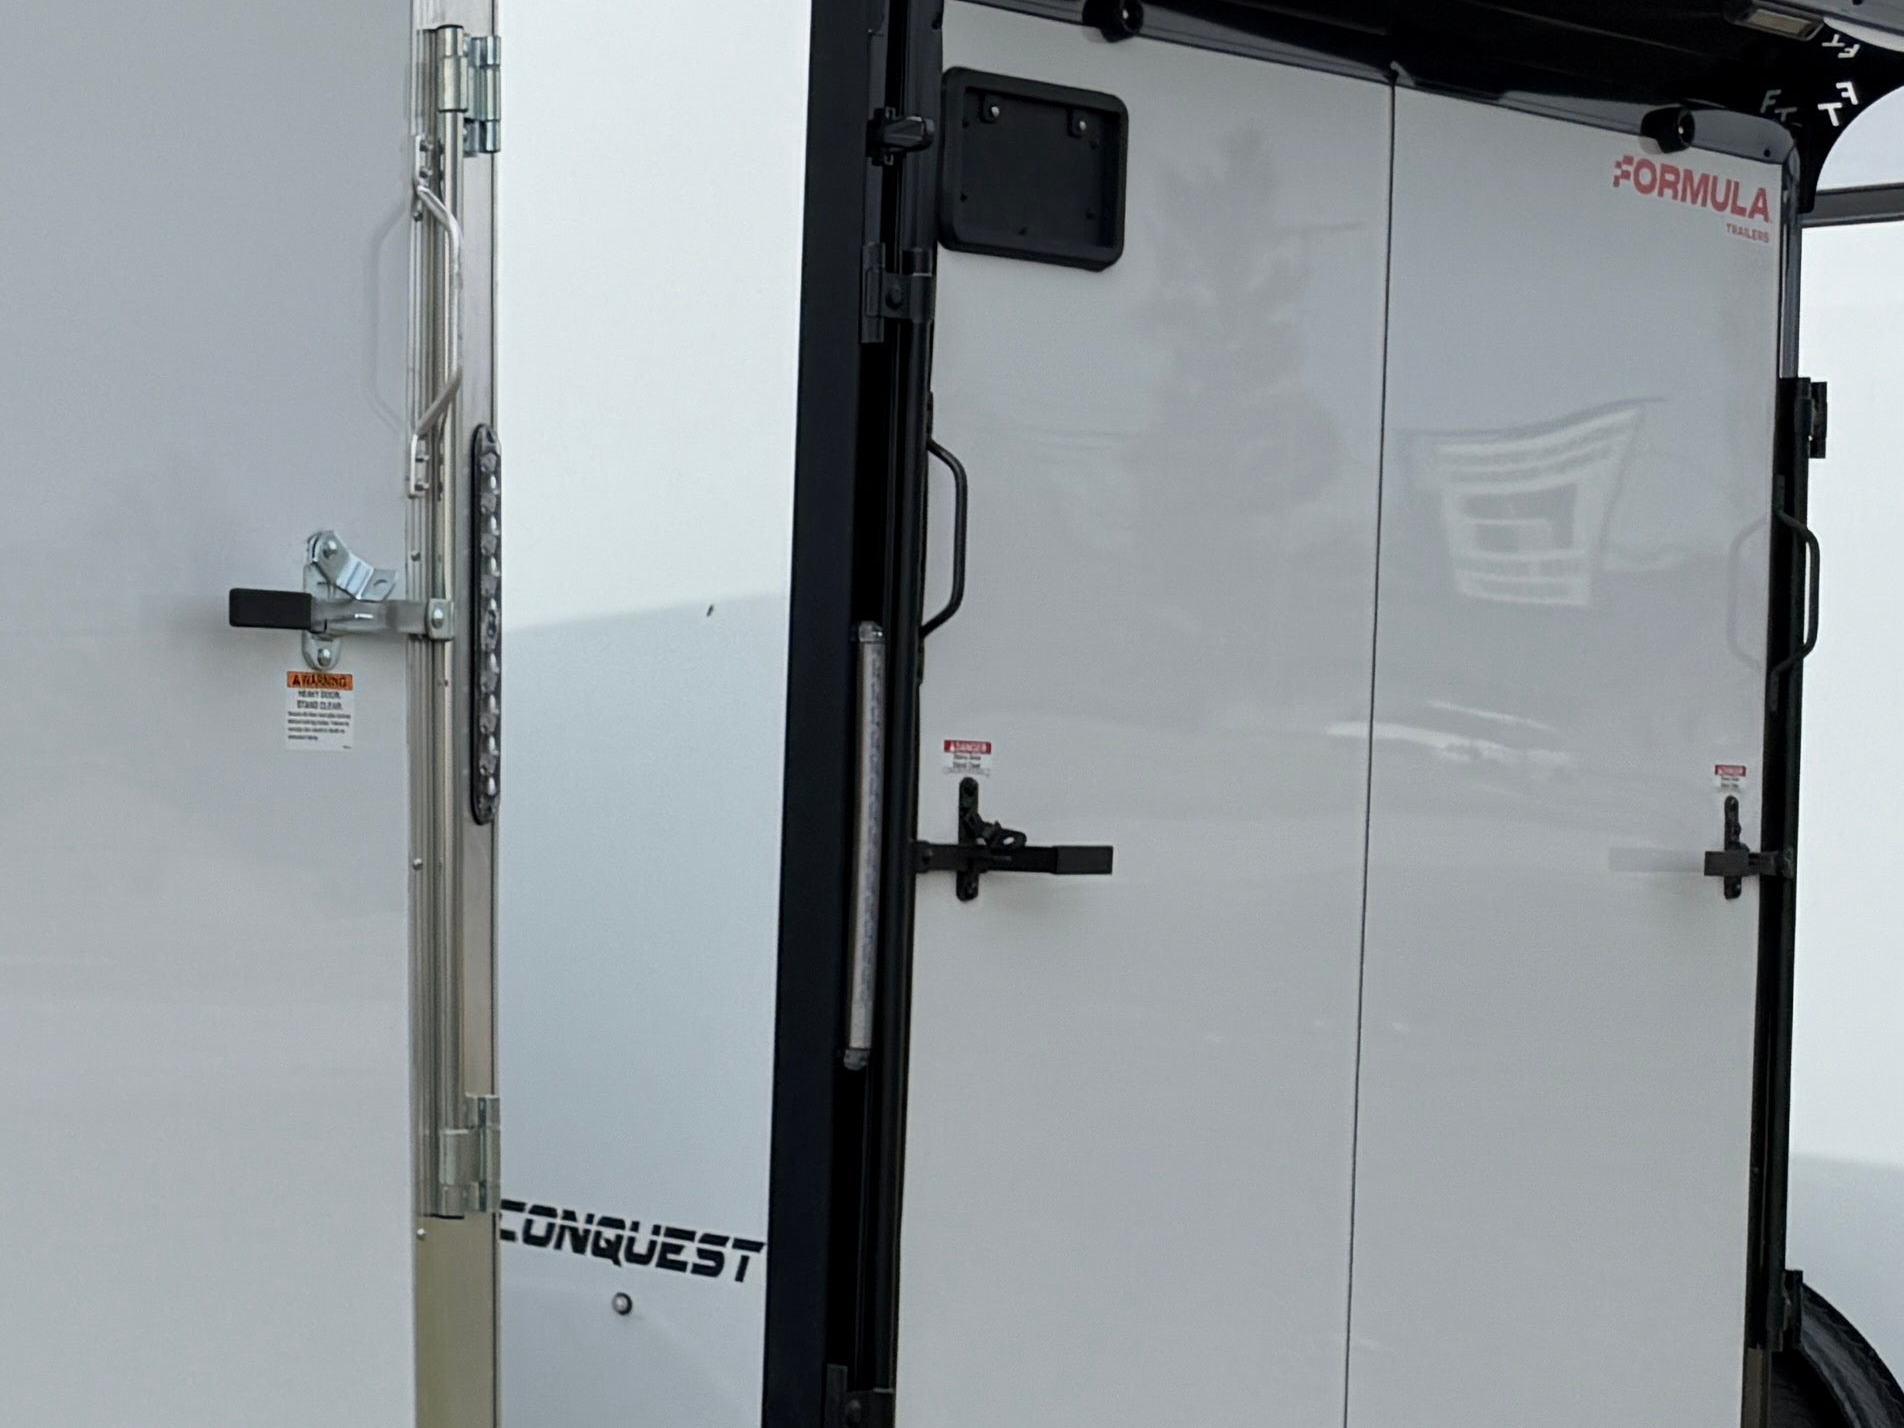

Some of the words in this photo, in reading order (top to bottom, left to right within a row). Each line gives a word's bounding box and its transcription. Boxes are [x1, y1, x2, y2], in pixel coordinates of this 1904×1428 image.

[1612, 154, 1771, 223] FORMULA
[1725, 222, 1770, 244] TRAILERS
[500, 1198, 767, 1283] CONQUEST
